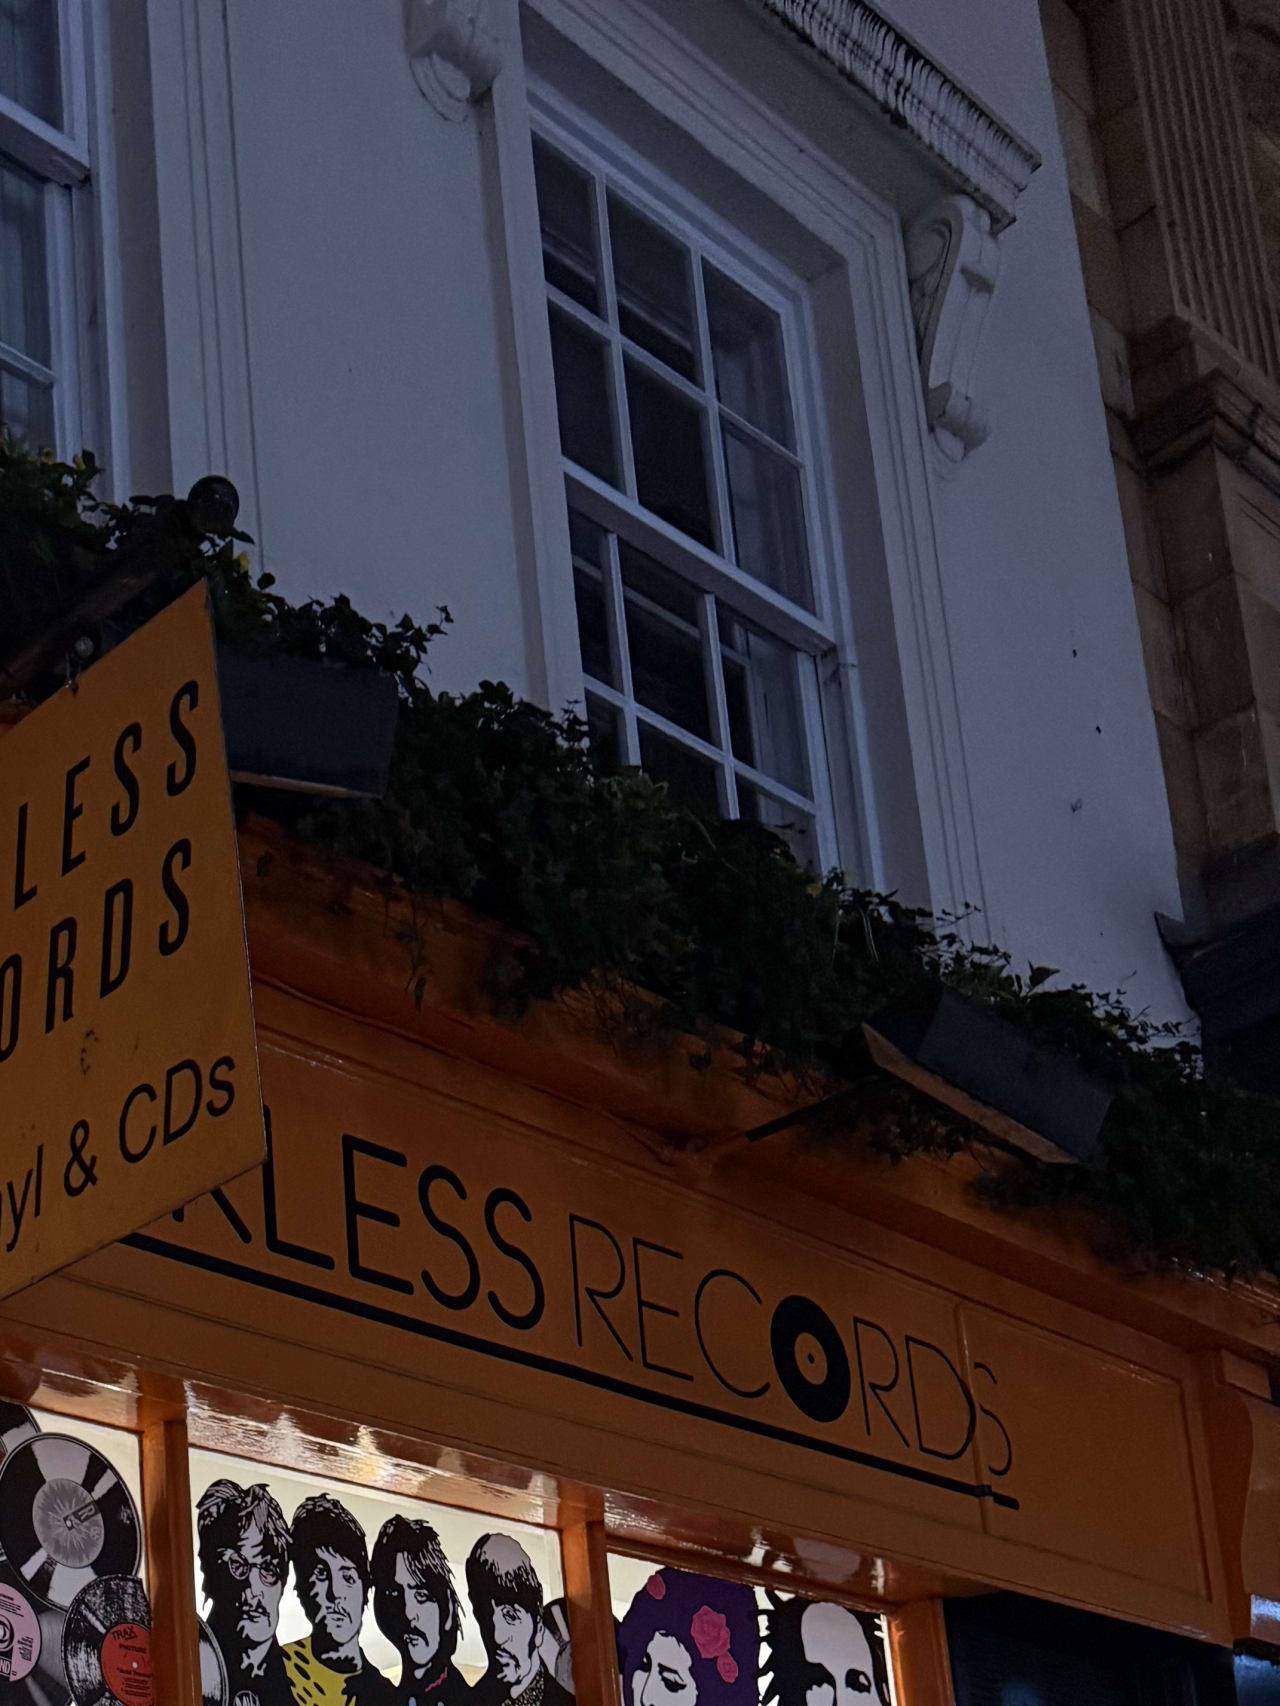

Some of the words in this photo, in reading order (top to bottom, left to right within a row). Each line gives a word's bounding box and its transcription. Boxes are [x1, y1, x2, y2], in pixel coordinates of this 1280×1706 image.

[63, 1119, 99, 1198] &
[120, 1054, 237, 1164] CDs
[568, 1213, 1013, 1478] RECORDS
